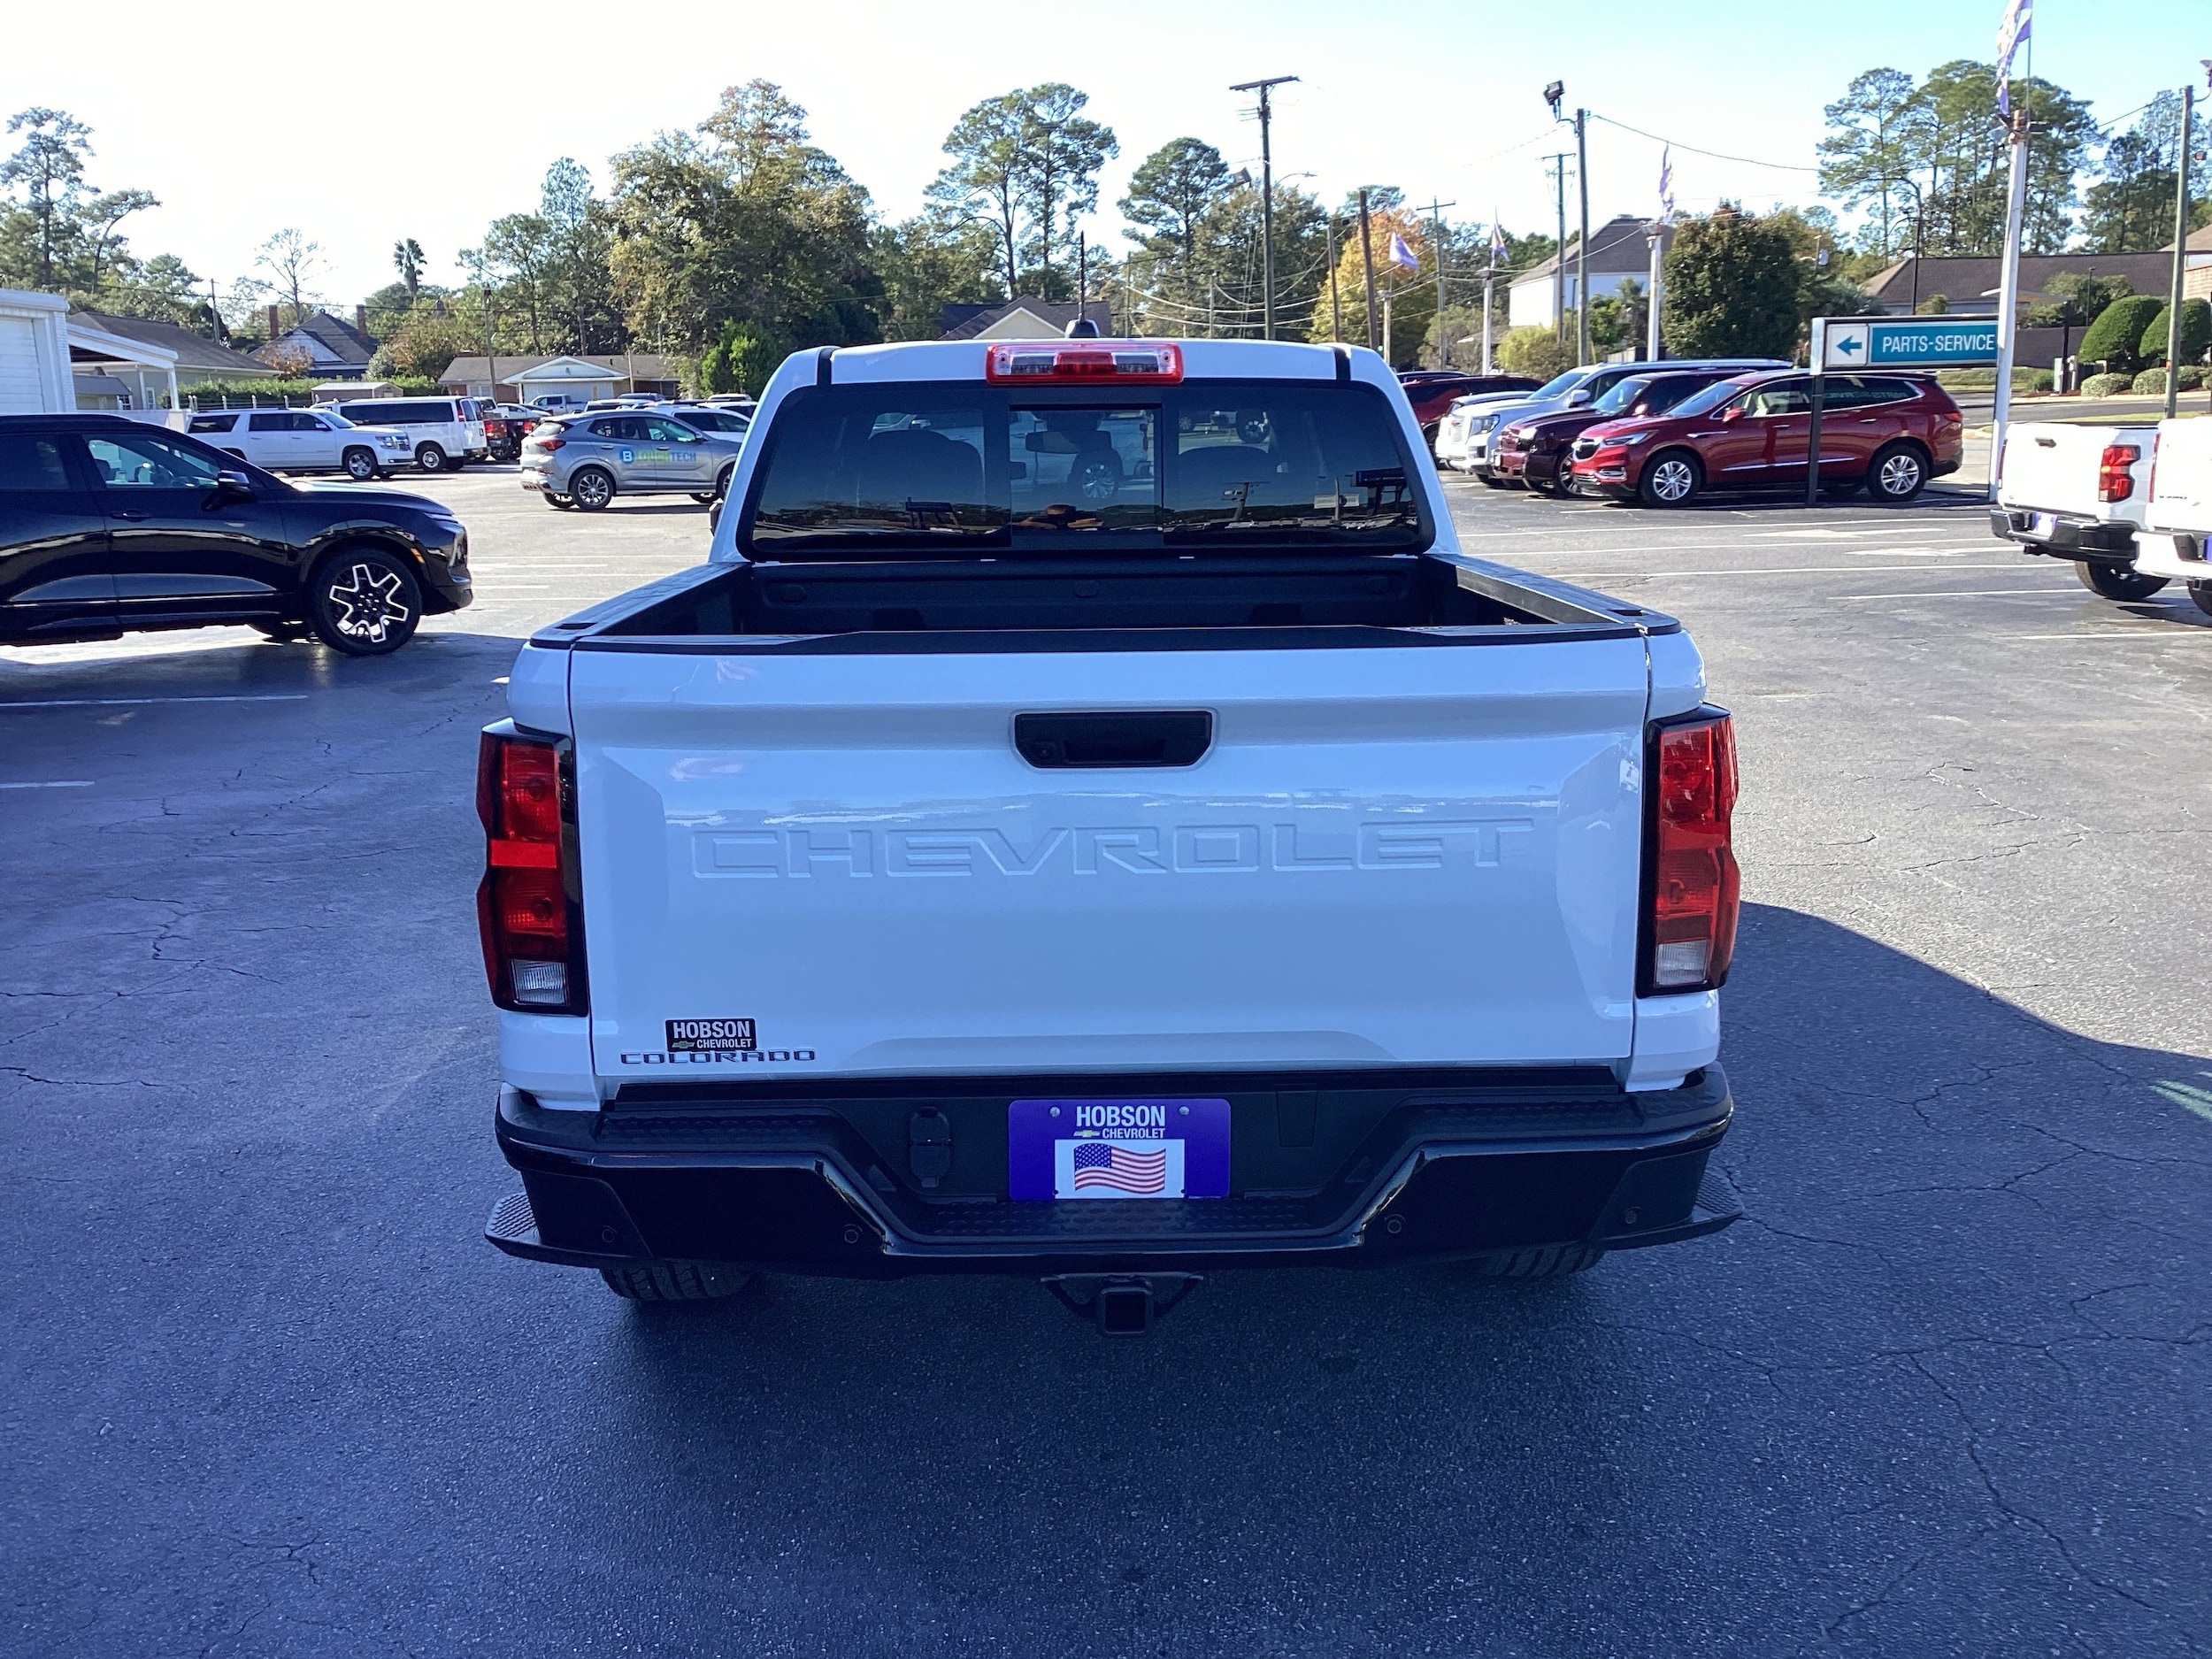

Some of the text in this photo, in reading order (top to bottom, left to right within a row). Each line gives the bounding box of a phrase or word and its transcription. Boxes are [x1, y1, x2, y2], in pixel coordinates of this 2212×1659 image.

[1882, 334, 1995, 352] PARTS-SERVICE
[693, 818, 1535, 879] CHEVROLET
[672, 1021, 750, 1039] HOBSON
[696, 1038, 753, 1049] CHEVROLET
[620, 1050, 815, 1064] COLORADO
[1076, 1105, 1165, 1126] HOBSON
[1102, 1127, 1166, 1139] CHEVROLET
